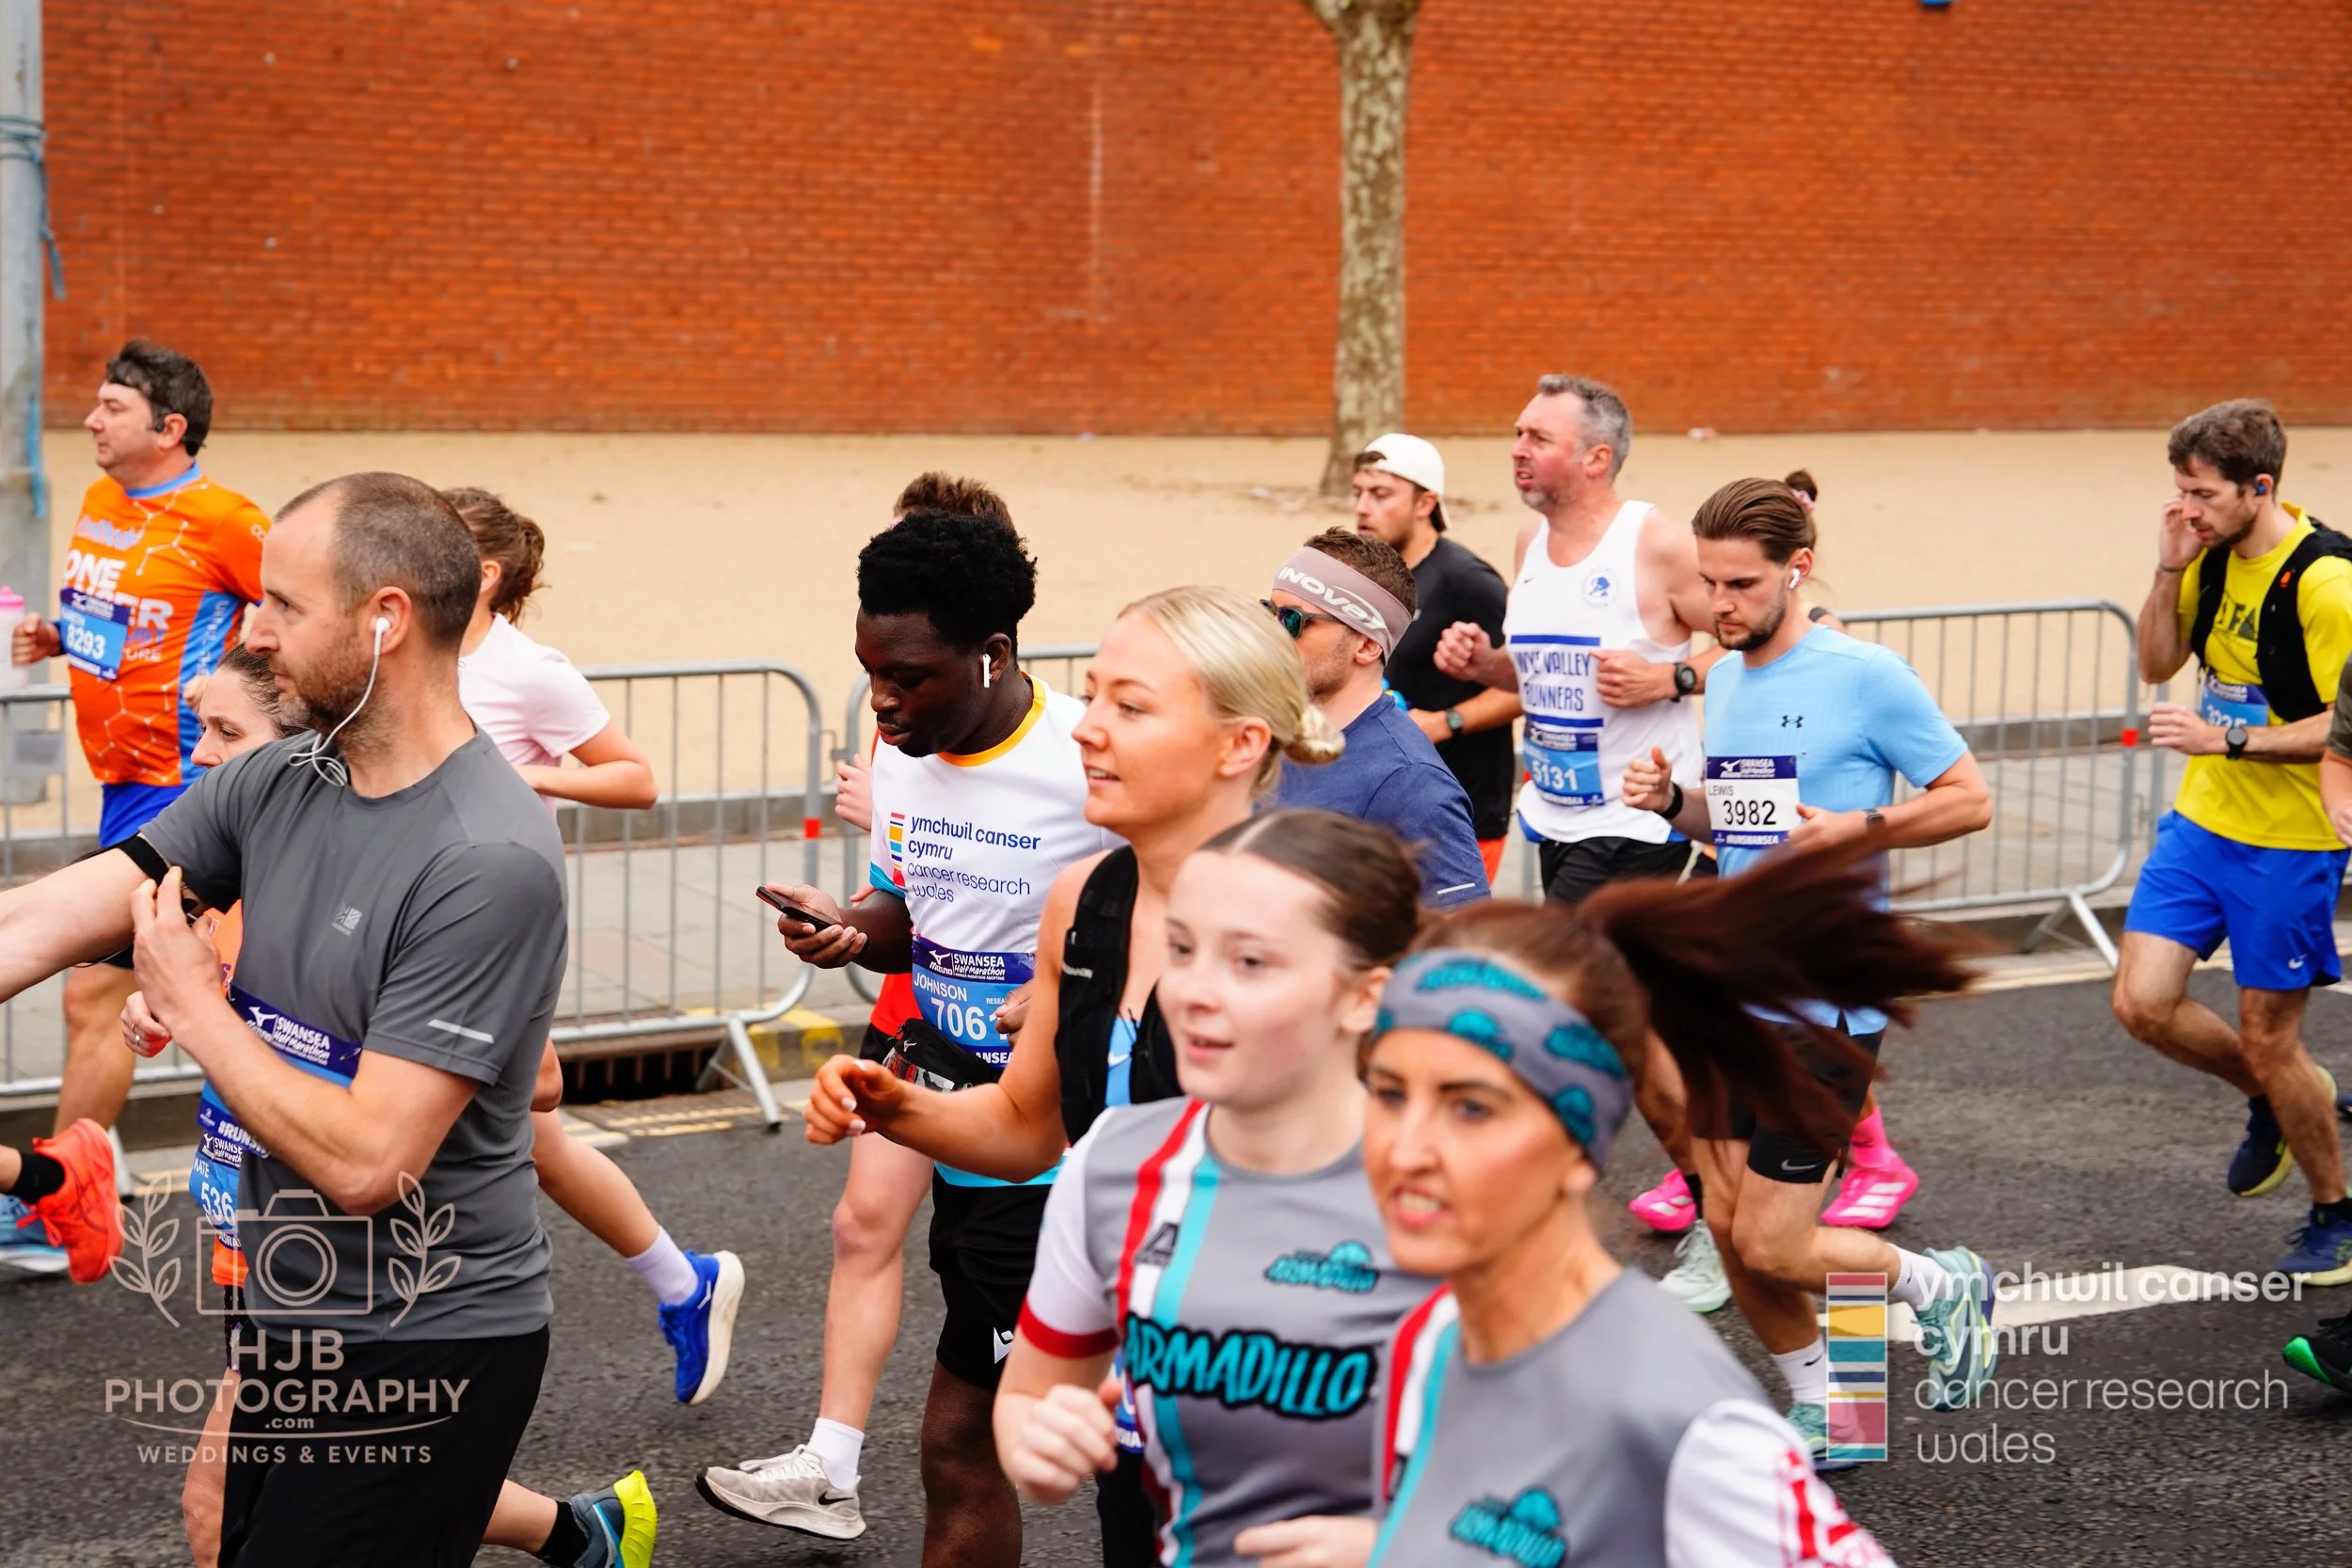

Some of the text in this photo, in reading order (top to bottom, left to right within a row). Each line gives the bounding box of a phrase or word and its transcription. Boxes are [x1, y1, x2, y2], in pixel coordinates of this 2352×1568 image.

[66, 623, 106, 660] 8293
[1542, 651, 1591, 676] VALLEY
[1523, 683, 1584, 712] RUNNERS
[1531, 761, 1579, 792] 5131
[1708, 785, 1734, 796] LEWIS
[1723, 800, 1776, 826] 3982
[910, 816, 1041, 850] ymchwil canser
[908, 839, 953, 861] cymru
[907, 862, 1031, 895] cancer research
[912, 882, 955, 903] wales
[953, 953, 1005, 968] SWANSEA
[954, 964, 970, 974] Half
[970, 965, 1006, 976] Marathon
[914, 973, 967, 1002] JOHNSON
[277, 1017, 331, 1050] SWANSEA
[194, 1157, 211, 1179] KATE
[200, 1180, 236, 1227] 536
[1124, 1315, 1370, 1415] ARMADILLO
